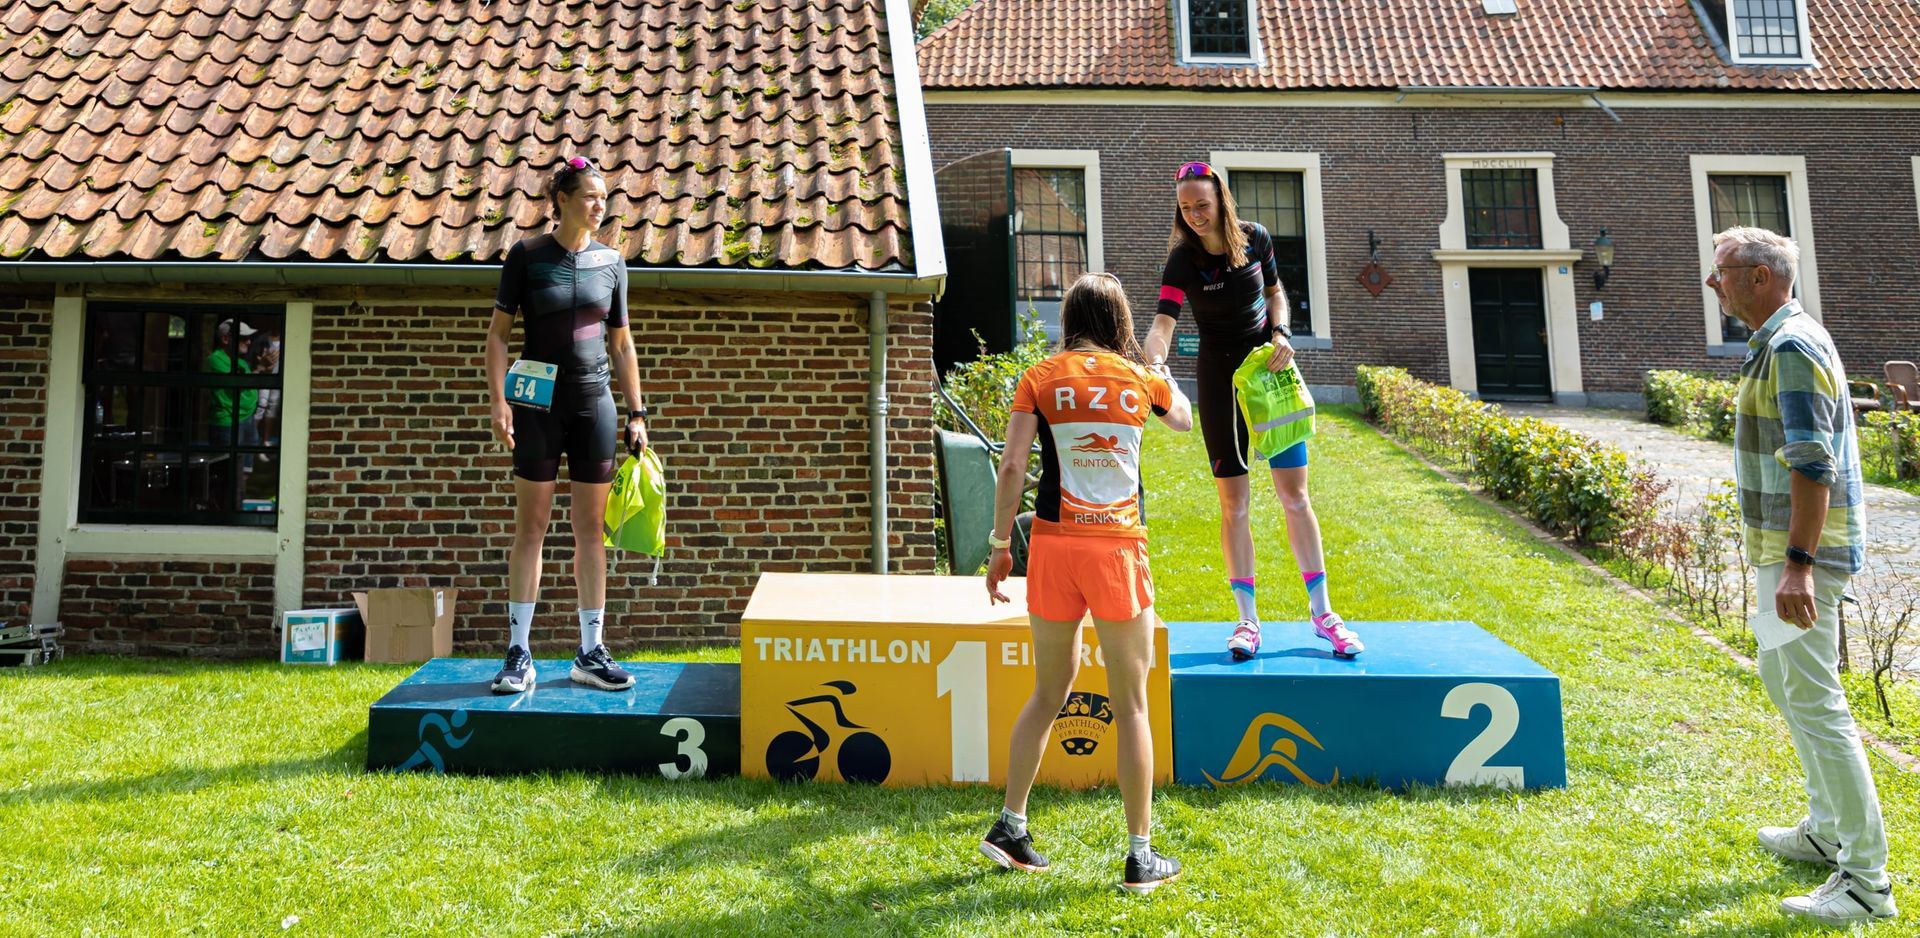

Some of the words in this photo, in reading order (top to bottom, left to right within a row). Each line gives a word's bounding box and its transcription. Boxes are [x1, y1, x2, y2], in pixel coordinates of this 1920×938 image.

[1472, 159, 1527, 169] MDCCLIII
[514, 377, 537, 400] 54
[1073, 458, 1127, 468] RIJNTOC
[754, 637, 931, 664] TRIATHLON
[936, 640, 990, 783] 1
[1058, 729, 1101, 739] EIBERGEN
[1440, 682, 1525, 790] 2
[658, 717, 708, 780] 3
